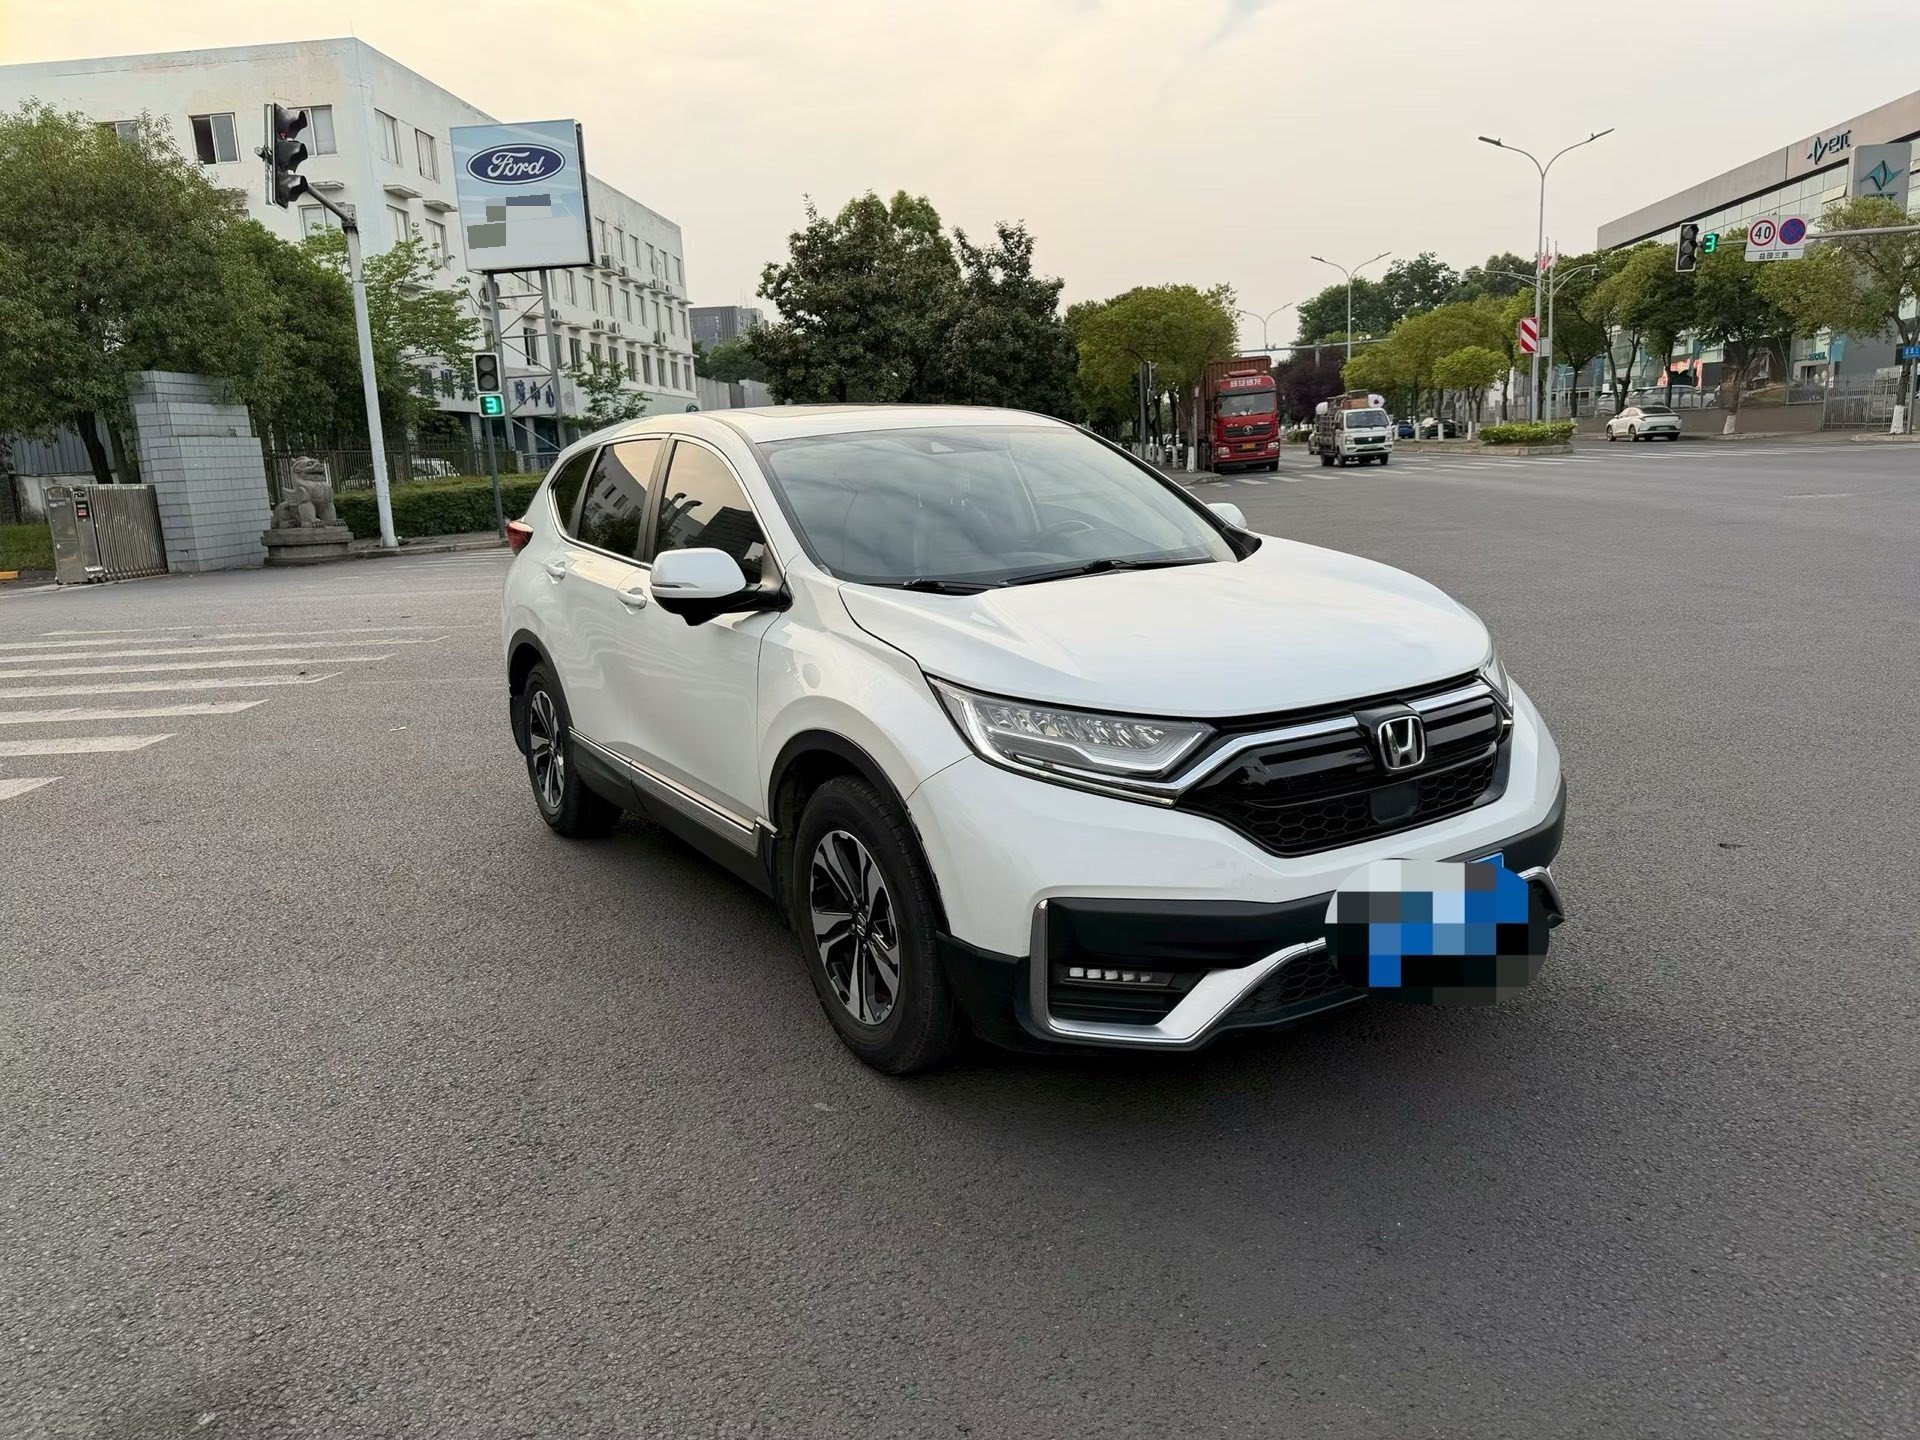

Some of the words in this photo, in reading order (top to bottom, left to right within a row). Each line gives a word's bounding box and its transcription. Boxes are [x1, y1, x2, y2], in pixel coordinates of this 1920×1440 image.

[487, 151, 545, 177] Ford
[1754, 226, 1771, 240] 40
[1704, 234, 1716, 253] 3
[485, 397, 497, 414] 3
